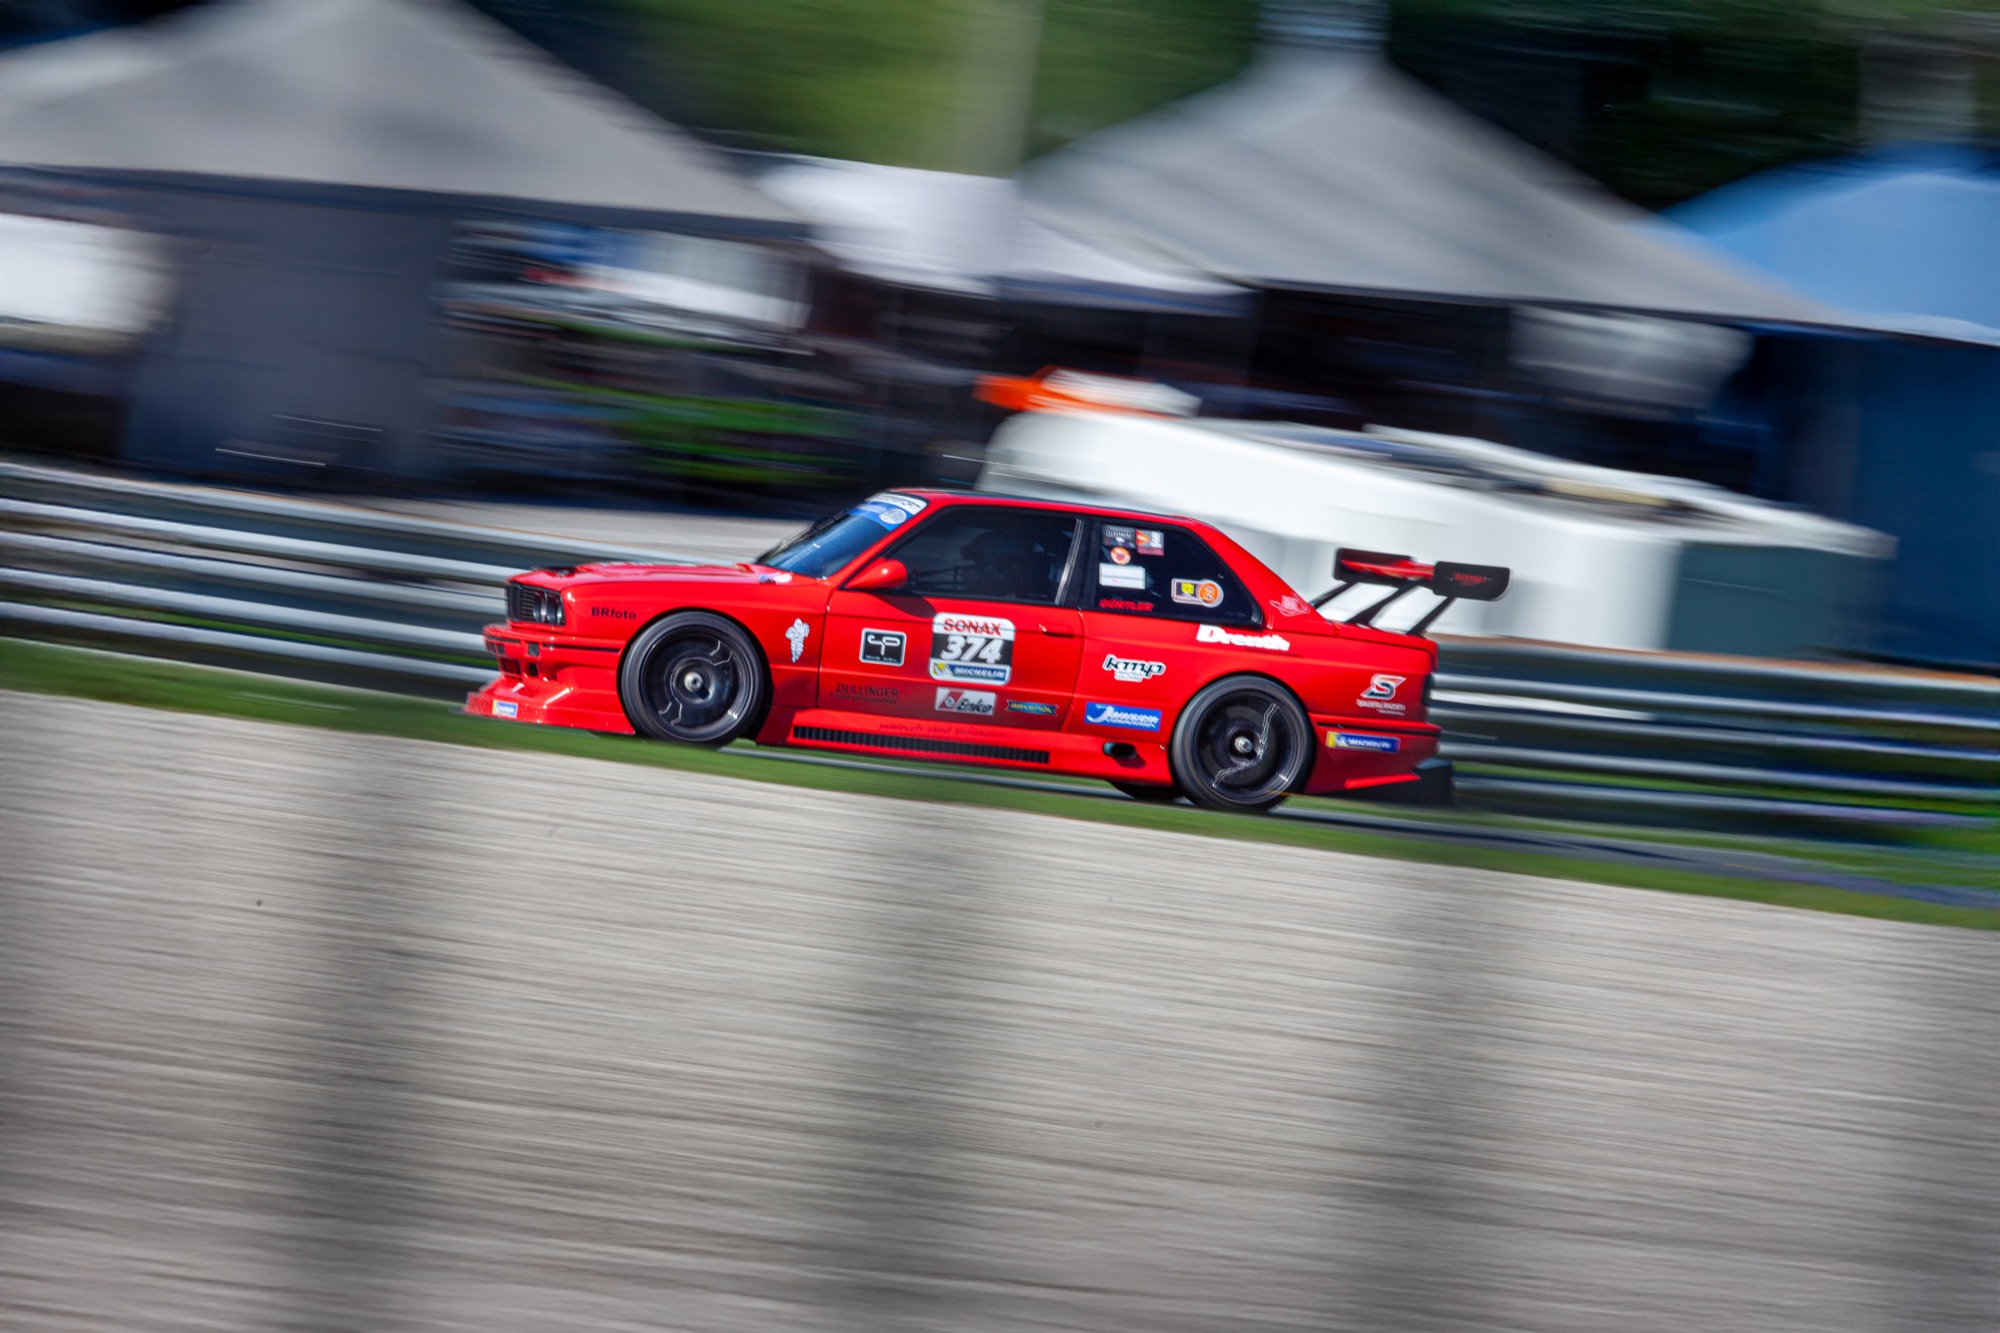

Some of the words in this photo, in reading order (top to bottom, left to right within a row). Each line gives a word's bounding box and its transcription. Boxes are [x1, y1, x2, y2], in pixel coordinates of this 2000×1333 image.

[591, 607, 637, 620] BRfoto
[943, 618, 1002, 636] SONAX
[940, 635, 1005, 665] 374
[954, 667, 1005, 678] MICHELIN
[1105, 657, 1163, 676] kmp
